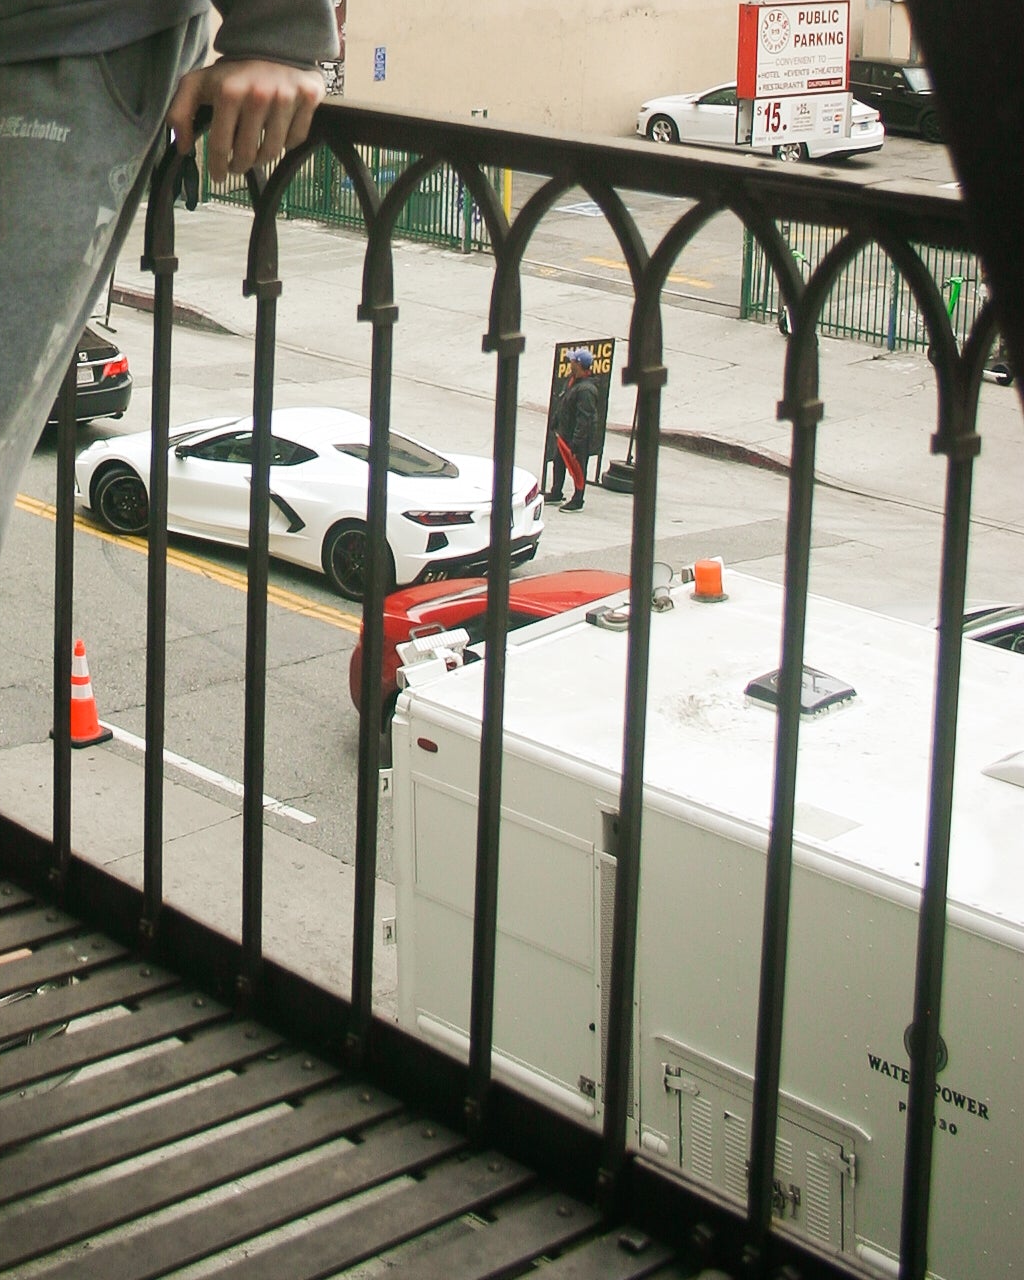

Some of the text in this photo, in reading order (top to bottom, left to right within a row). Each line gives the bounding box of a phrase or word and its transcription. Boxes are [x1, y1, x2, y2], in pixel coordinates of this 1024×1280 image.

[798, 10, 839, 25] PUBLIC
[793, 31, 844, 48] PARKING
[775, 55, 826, 67] CONVENIENT TO
[560, 343, 612, 362] PLIC
[868, 1053, 910, 1084] WATE
